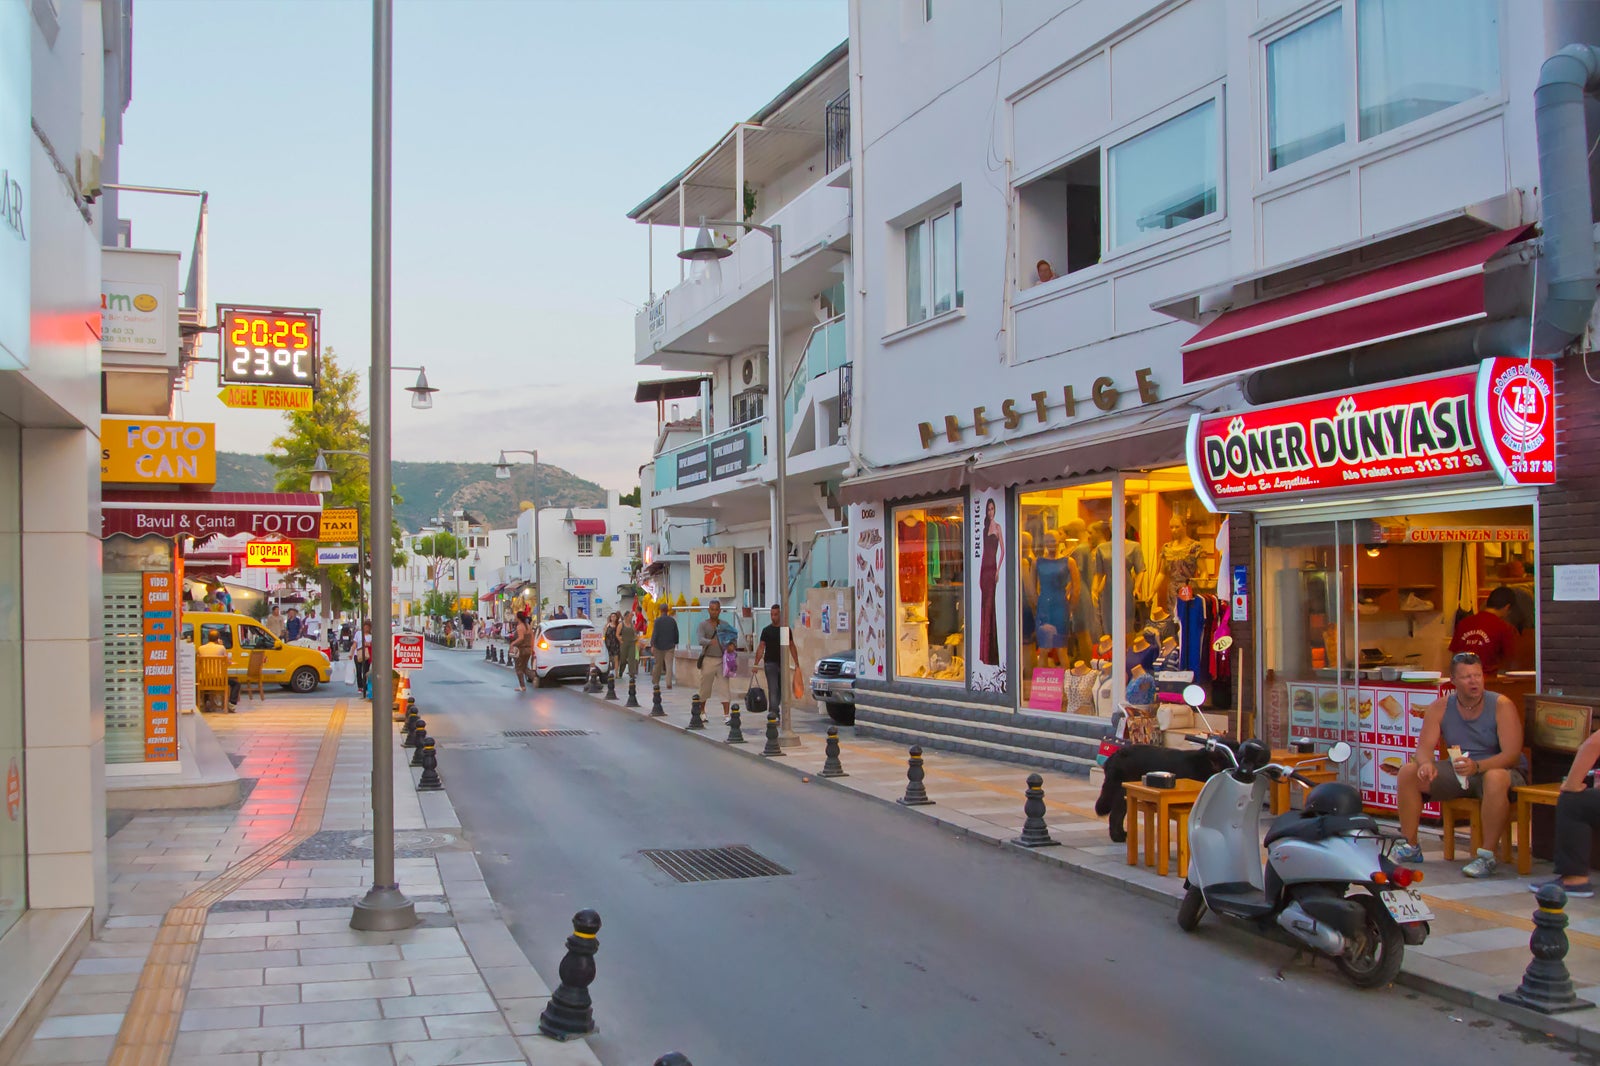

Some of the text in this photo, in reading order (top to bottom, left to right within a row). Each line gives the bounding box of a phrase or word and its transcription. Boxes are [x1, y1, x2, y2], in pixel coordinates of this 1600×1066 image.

[231, 318, 309, 348] 20:25
[1493, 363, 1551, 397] DÖNER DÜNYASI
[227, 389, 257, 405] ACELE
[1511, 386, 1522, 413] 7
[918, 368, 1160, 449] PRESTIGE
[127, 425, 206, 450] FOTO
[1205, 394, 1476, 481] DÖNER DÜNYASI
[135, 454, 197, 478] CAN
[1342, 470, 1360, 481] Alo
[1360, 466, 1393, 479] Paket
[1415, 459, 1442, 472] 313
[1443, 456, 1460, 469] 37
[1463, 454, 1483, 467] 36
[1512, 461, 1553, 473] 313 37 36
[136, 514, 315, 532] Bavul & Çanta FOTO
[323, 521, 352, 530] TAXI
[249, 545, 289, 556] OTOPARK
[580, 578, 595, 586] PARK
[1215, 639, 1227, 650] 20
[1398, 903, 1420, 916] 214
